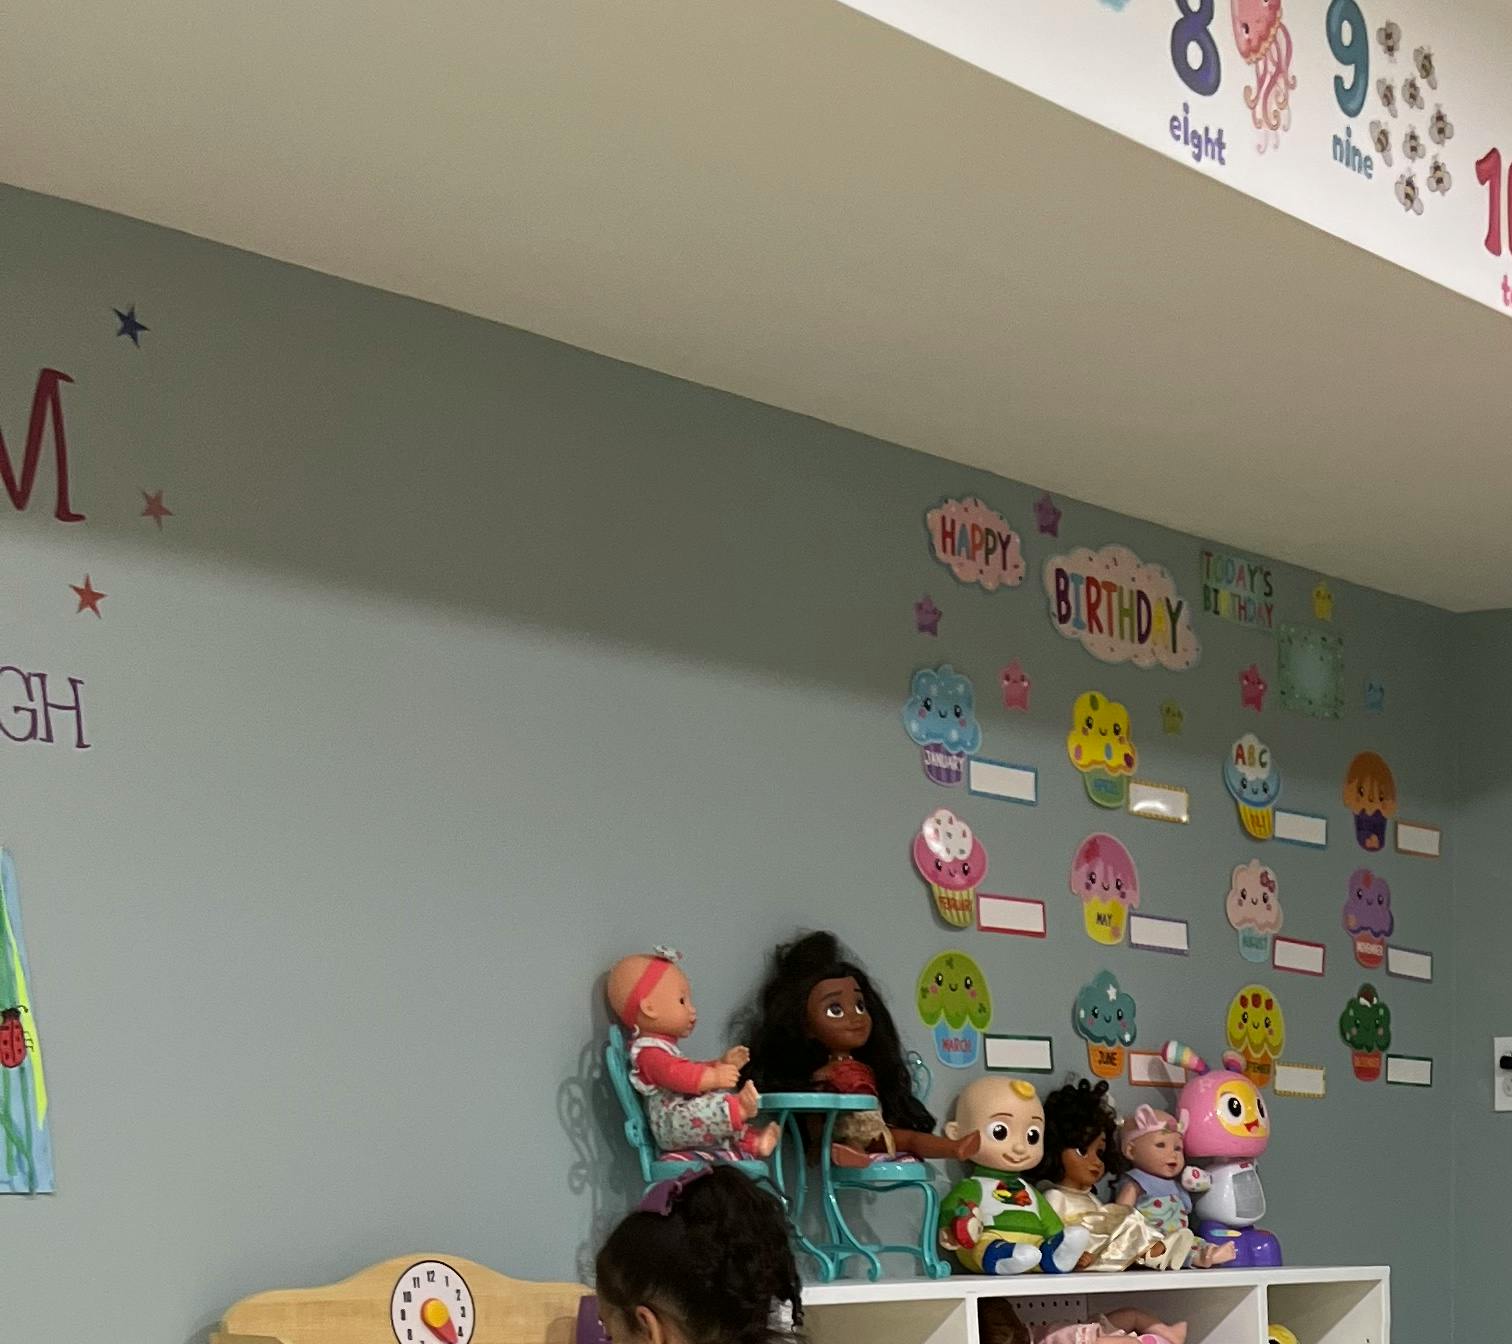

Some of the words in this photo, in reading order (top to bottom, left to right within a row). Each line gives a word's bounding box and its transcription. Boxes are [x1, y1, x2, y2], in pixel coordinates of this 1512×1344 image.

[1171, 0, 1221, 96] 8
[1326, 0, 1369, 118] 9
[1169, 102, 1226, 165] eight
[1332, 126, 1374, 179] nine
[940, 515, 1012, 571] HAPPY
[1203, 551, 1273, 597] TODAY'S
[1055, 567, 1183, 654] BIRTHDAY
[1202, 584, 1273, 629] BIRTHDAY
[924, 750, 965, 771] JANUARY
[1234, 743, 1268, 768] ABC
[1096, 911, 1112, 928] MAY
[943, 1037, 973, 1053] MARCH
[1098, 1050, 1118, 1067] JUNE
[412, 1276, 421, 1289] 11
[426, 1270, 435, 1283] 12
[444, 1275, 450, 1287] 1
[403, 1291, 412, 1303] 10
[455, 1289, 461, 1301] 2
[460, 1306, 466, 1318] 3
